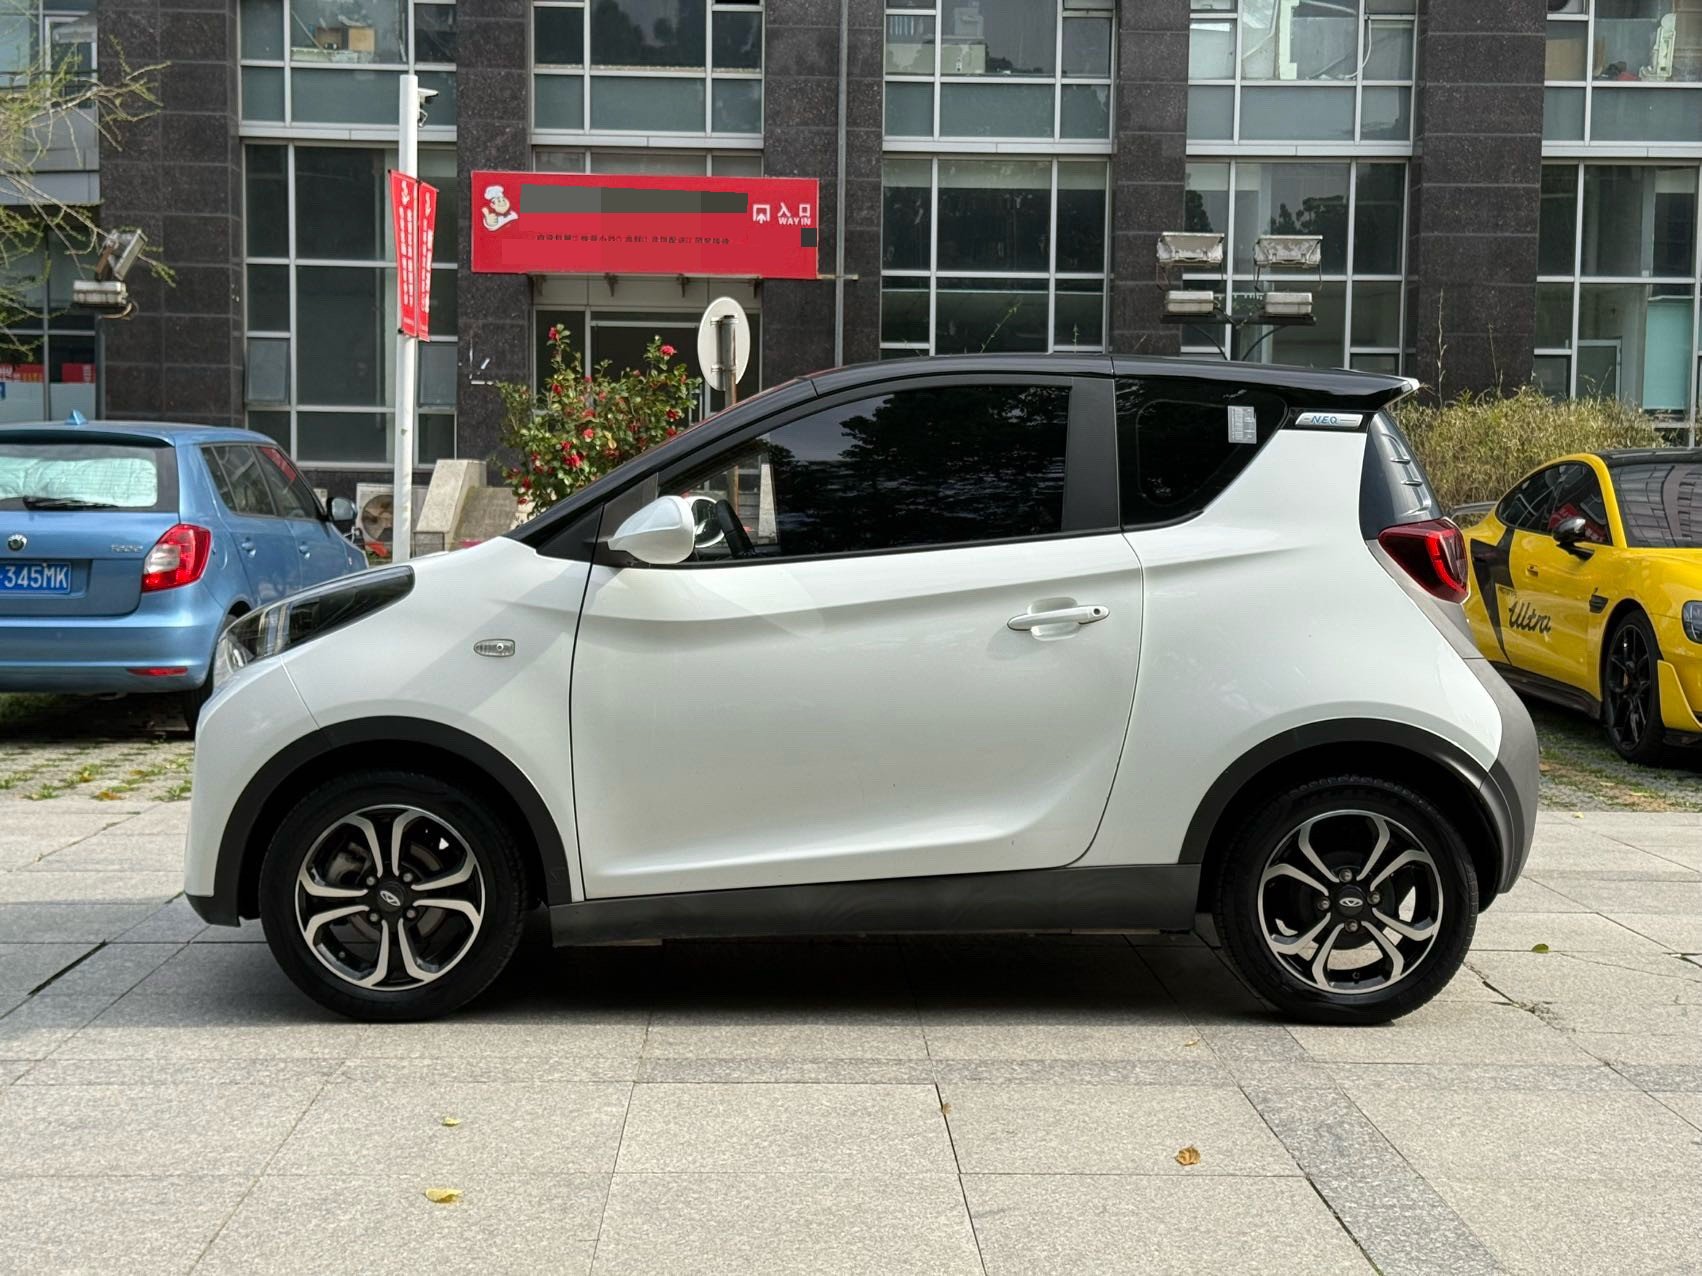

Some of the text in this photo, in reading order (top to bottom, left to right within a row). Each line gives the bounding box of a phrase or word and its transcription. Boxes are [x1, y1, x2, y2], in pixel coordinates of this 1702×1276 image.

[777, 201, 811, 217] 入口
[778, 217, 812, 226] WAY IN
[1508, 600, 1552, 634] Ultra
